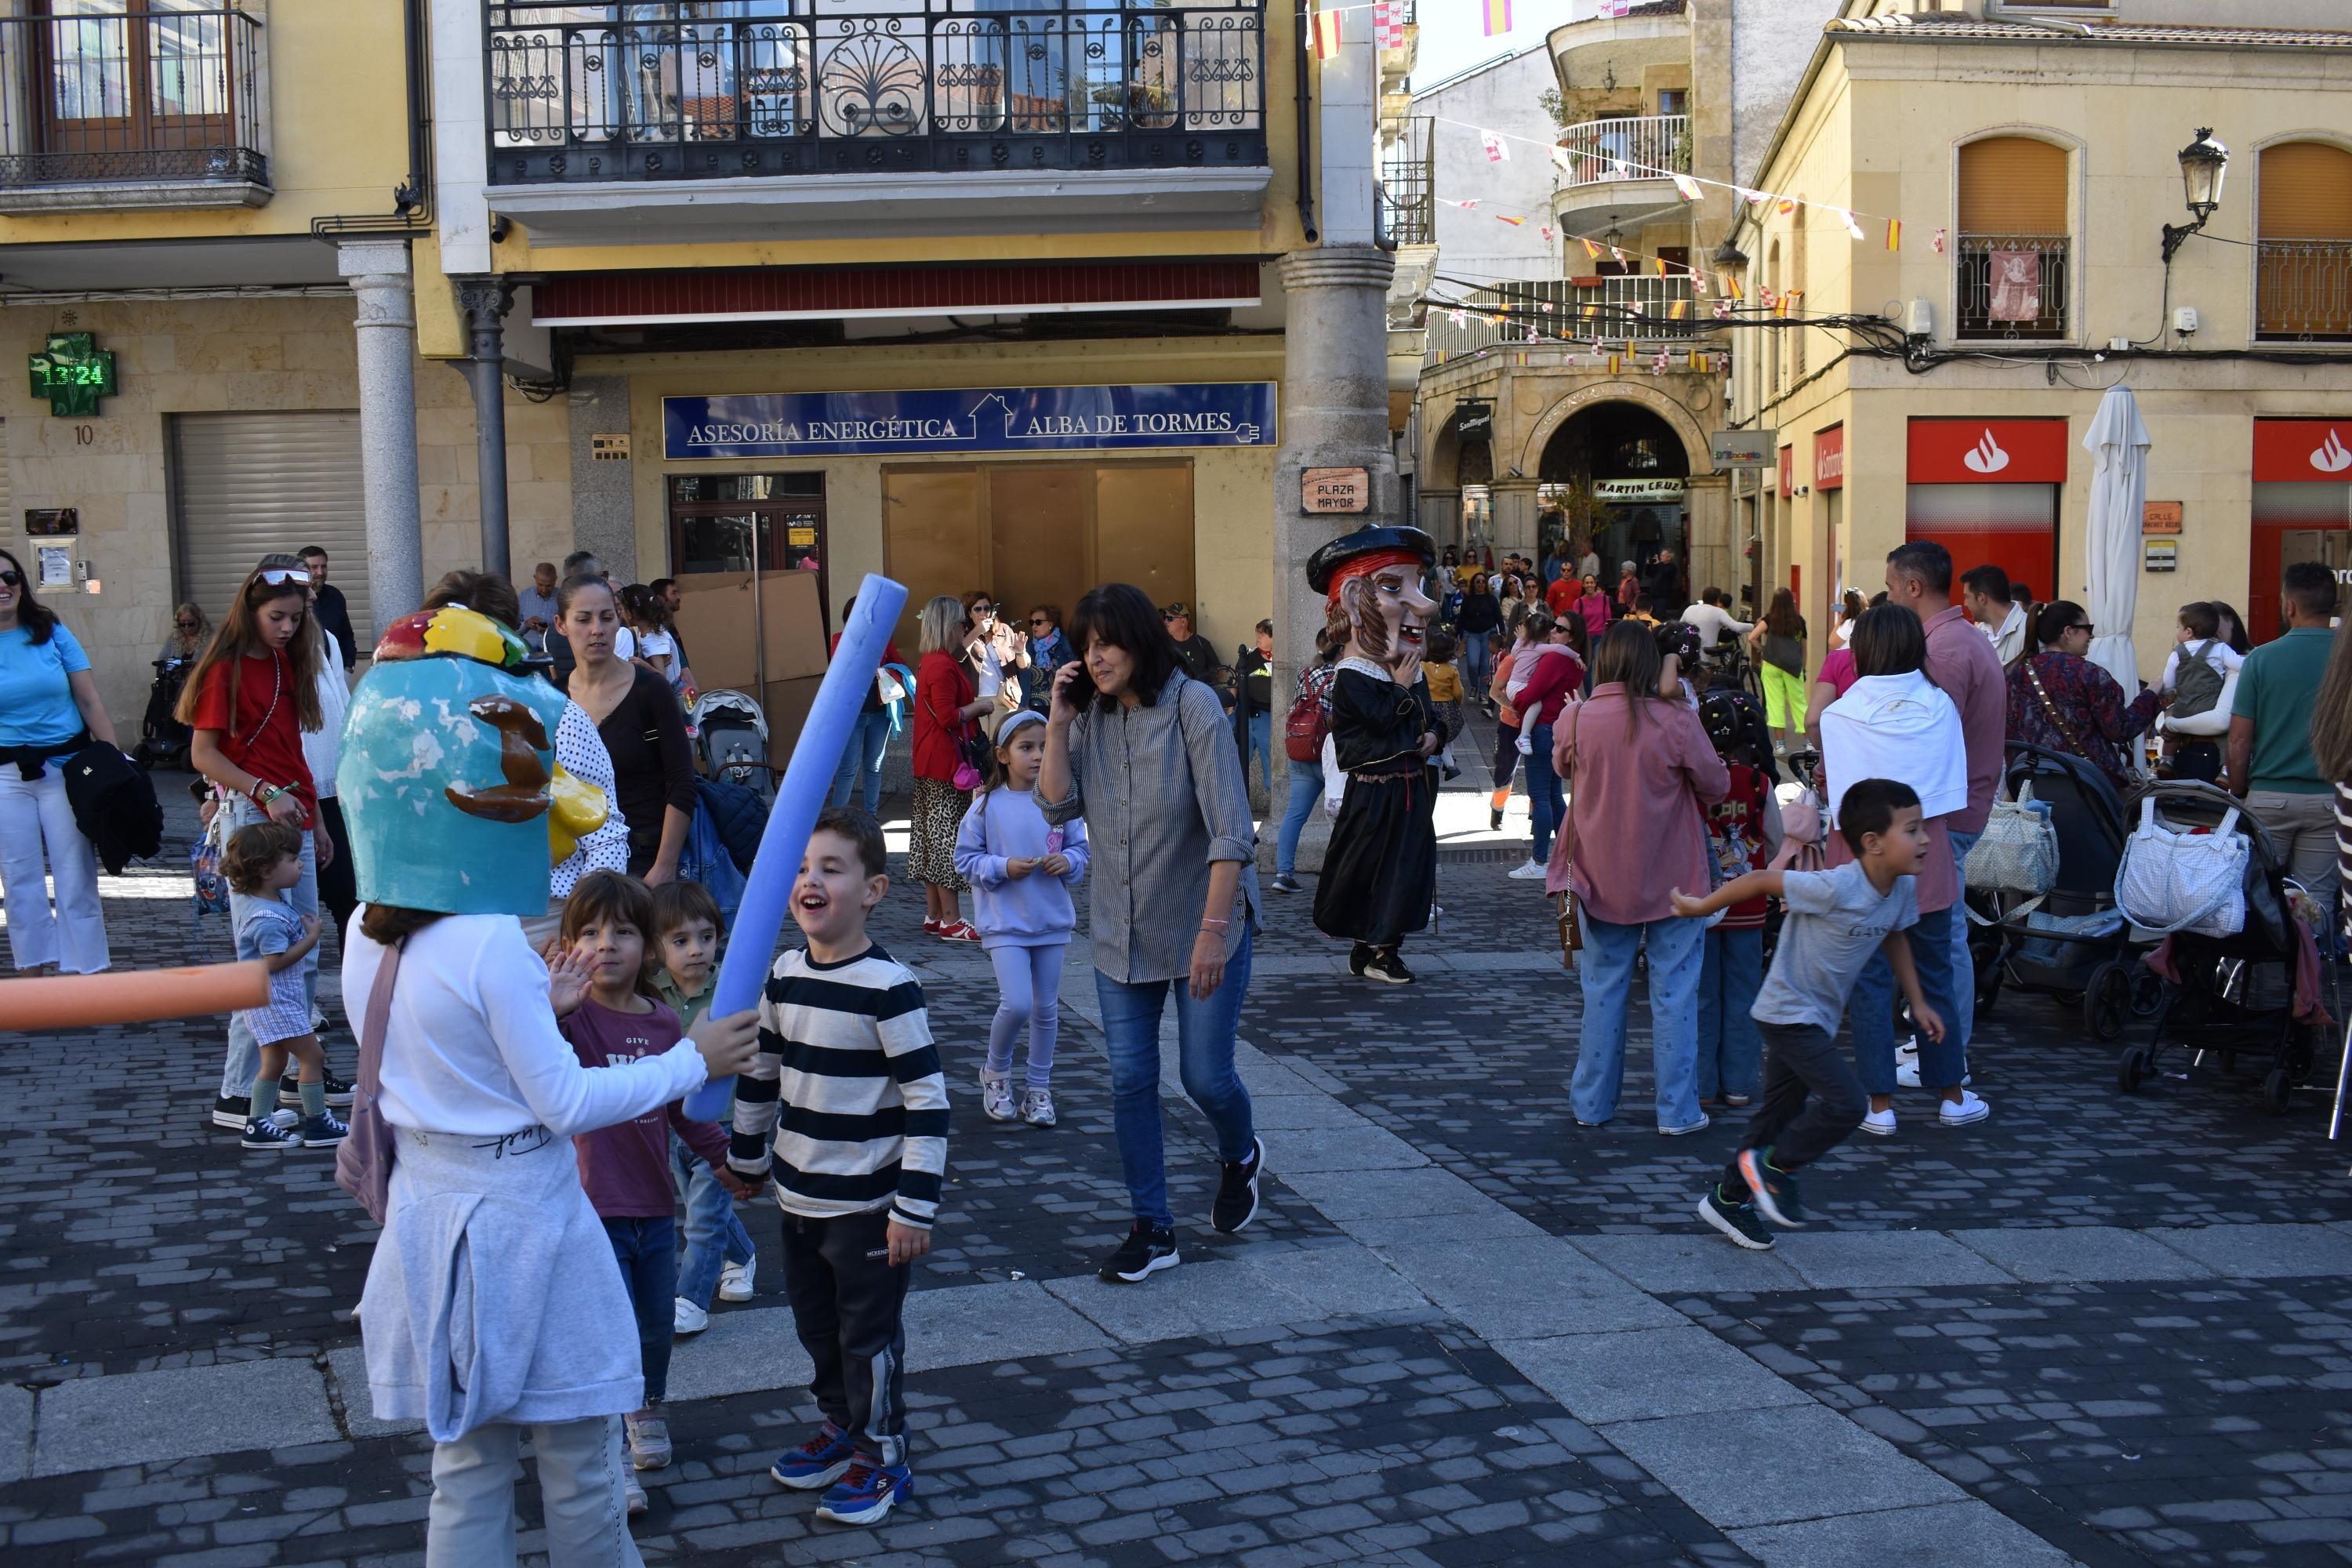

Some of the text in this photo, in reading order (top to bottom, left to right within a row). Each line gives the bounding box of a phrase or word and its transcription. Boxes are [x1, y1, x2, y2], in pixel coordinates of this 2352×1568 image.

[42, 365, 103, 385] 13:24
[688, 412, 1232, 444] ASESORÍA ENERGÉTICA ALBA DE TORMES
[74, 425, 93, 445] 10
[1318, 485, 1355, 495] PLAZA
[1595, 481, 1680, 494] MARTIN CRUZ
[1318, 498, 1355, 508] MAYOR
[626, 1037, 650, 1046] GIVE
